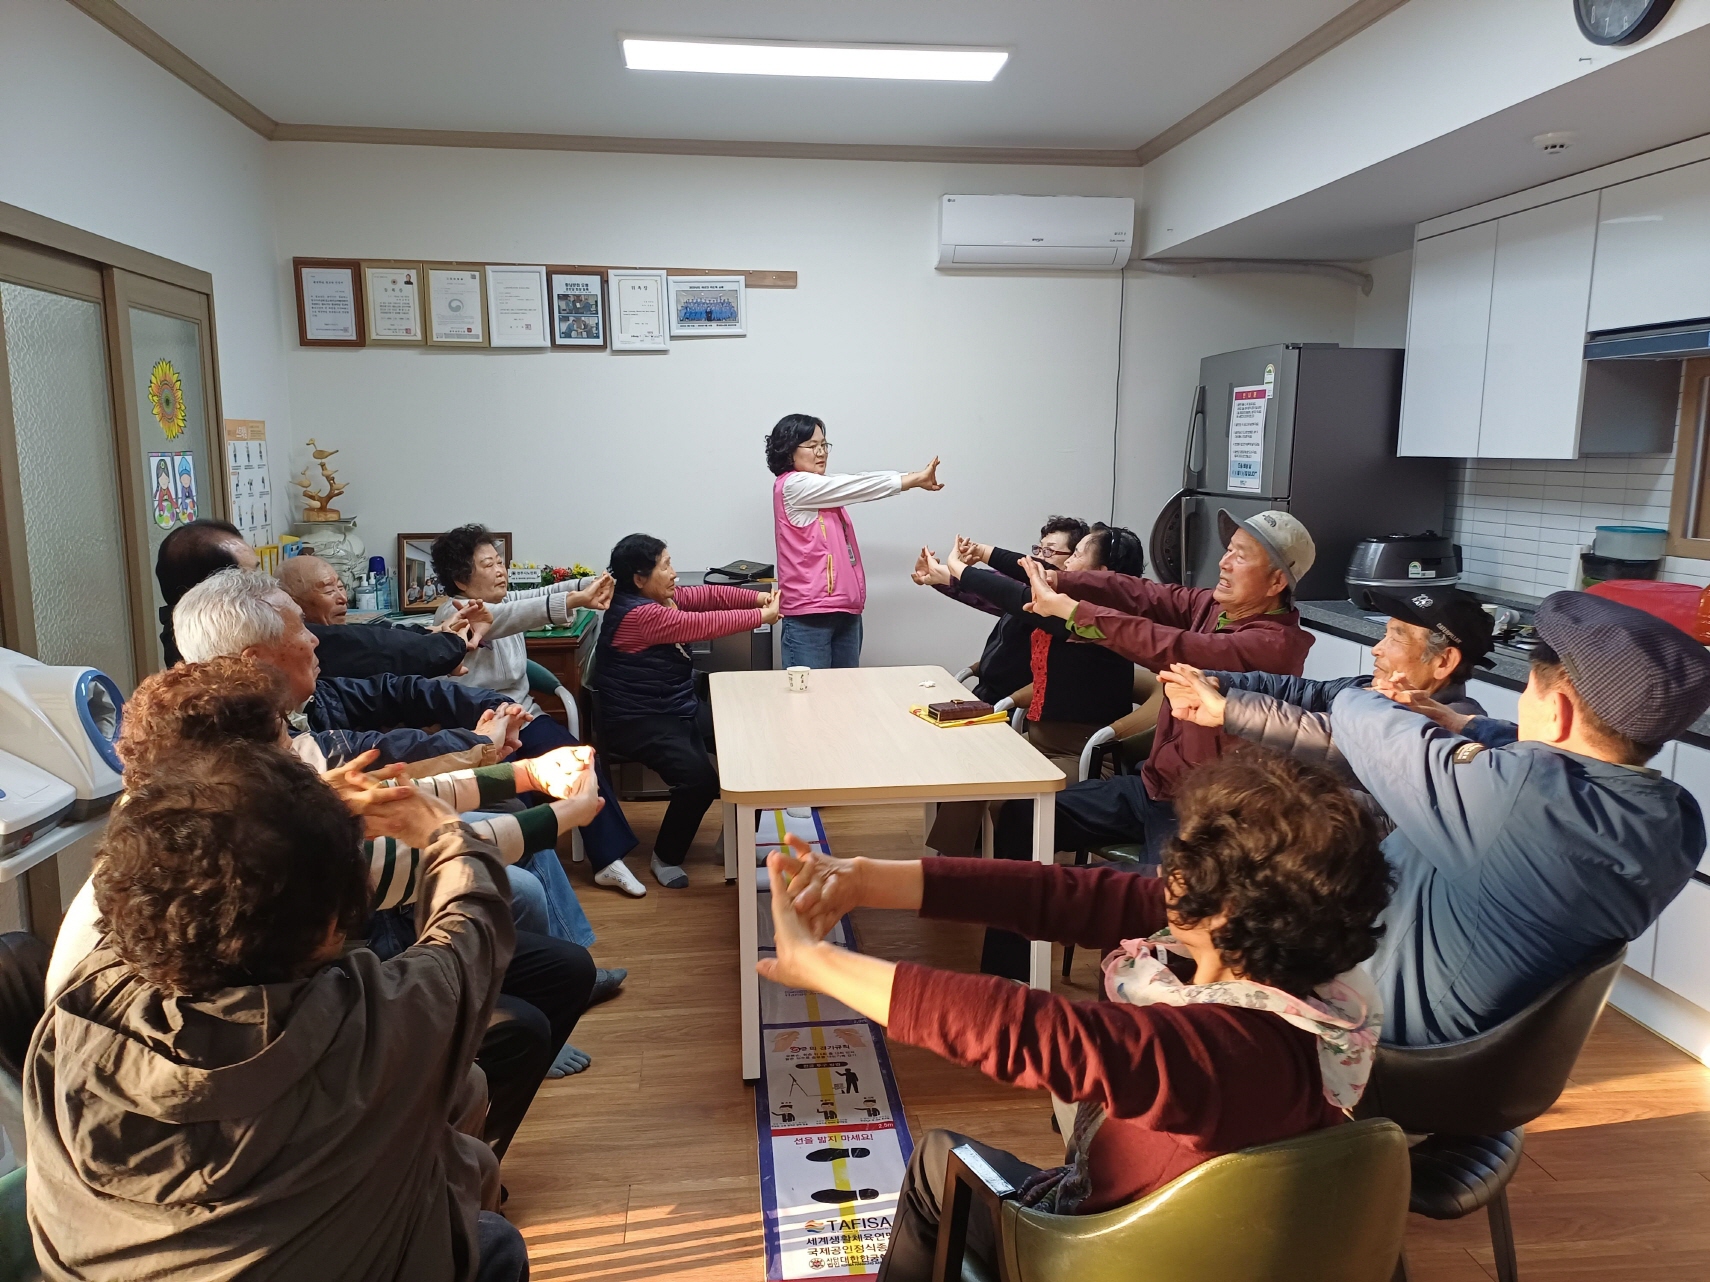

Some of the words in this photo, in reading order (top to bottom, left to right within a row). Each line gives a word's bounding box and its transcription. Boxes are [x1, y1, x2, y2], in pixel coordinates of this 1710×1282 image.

[1591, 6, 1596, 24] 8
[1604, 17, 1609, 35] 7
[1436, 622, 1463, 644] CATERPILLAR
[794, 1136, 814, 1145] 선을
[817, 1135, 837, 1143] 밟지
[841, 1133, 874, 1142] 마세요!
[827, 1217, 892, 1231] TAFISA
